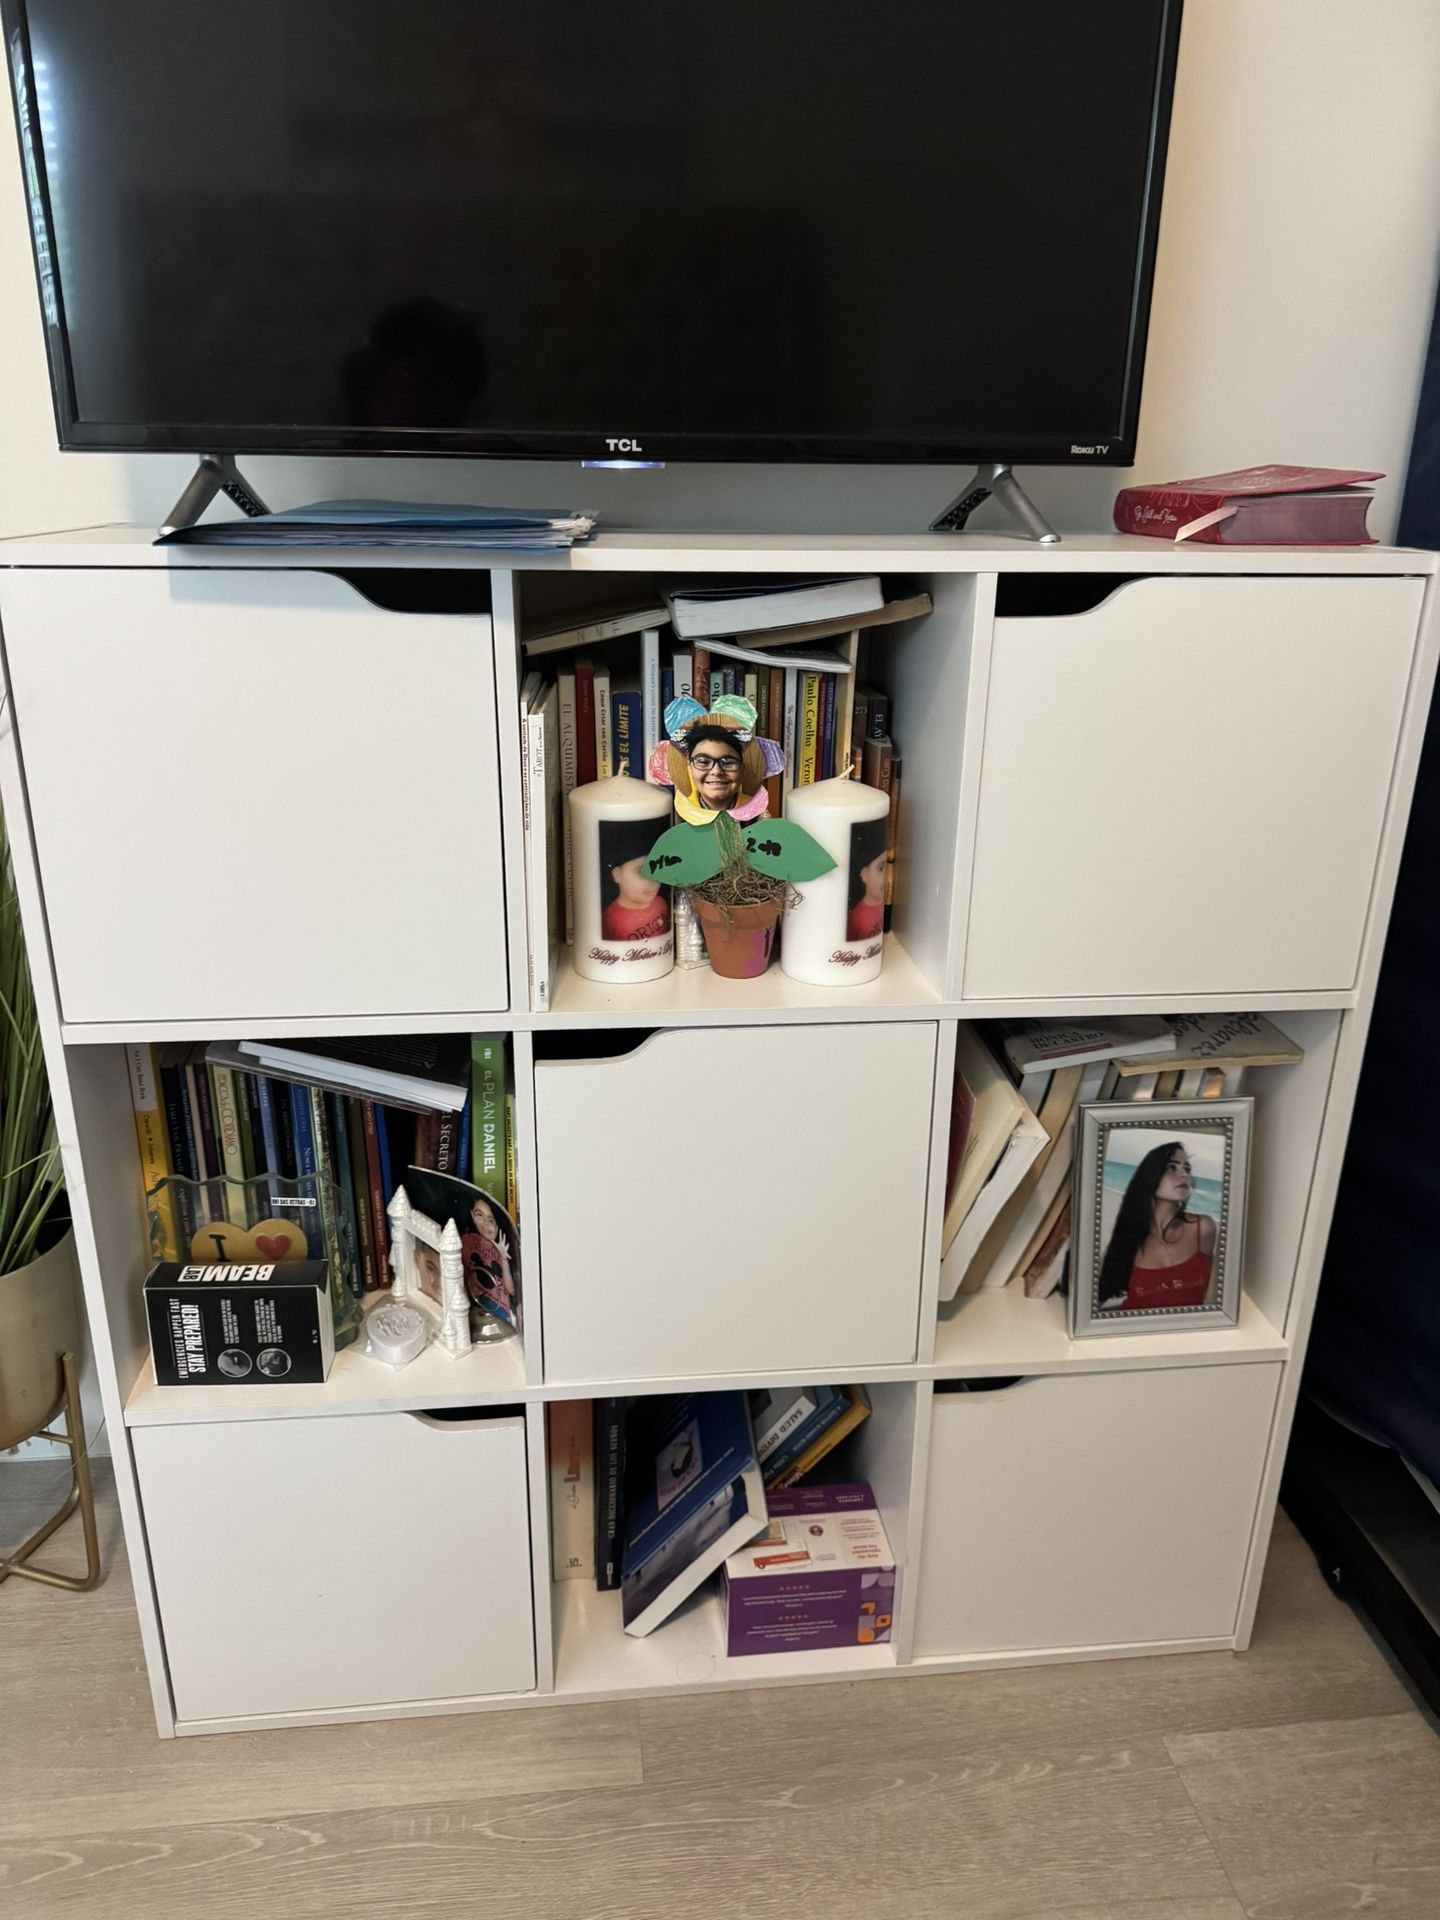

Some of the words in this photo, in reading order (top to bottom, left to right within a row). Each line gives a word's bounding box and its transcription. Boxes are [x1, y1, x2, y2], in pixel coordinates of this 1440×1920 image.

[605, 438, 642, 452] TCL
[1070, 444, 1095, 454] Roku
[1095, 445, 1109, 454] TV
[807, 676, 817, 706] Paulo
[563, 704, 572, 717] EL
[617, 703, 630, 736] LÍMITE
[804, 709, 817, 748] Coelho
[619, 737, 631, 754] EL
[588, 946, 620, 966] Happy
[828, 951, 862, 967] Happy
[484, 1070, 492, 1081] EL
[483, 1083, 495, 1120] PLAN
[438, 1124, 453, 1170] SECRETO
[483, 1123, 496, 1174] DANIEL
[279, 1198, 288, 1206] DAS
[208, 1234, 232, 1262] I
[201, 1264, 276, 1282] BEAM
[168, 1298, 180, 1313] FAST
[170, 1314, 184, 1338] HAPPEN
[180, 1304, 204, 1351] PREPARED!
[174, 1339, 189, 1379] EMERGENCIES
[186, 1352, 207, 1373] STAY
[779, 1408, 804, 1433] SALUD
[610, 1465, 618, 1475] DE
[608, 1476, 617, 1519] DICCIONARIO
